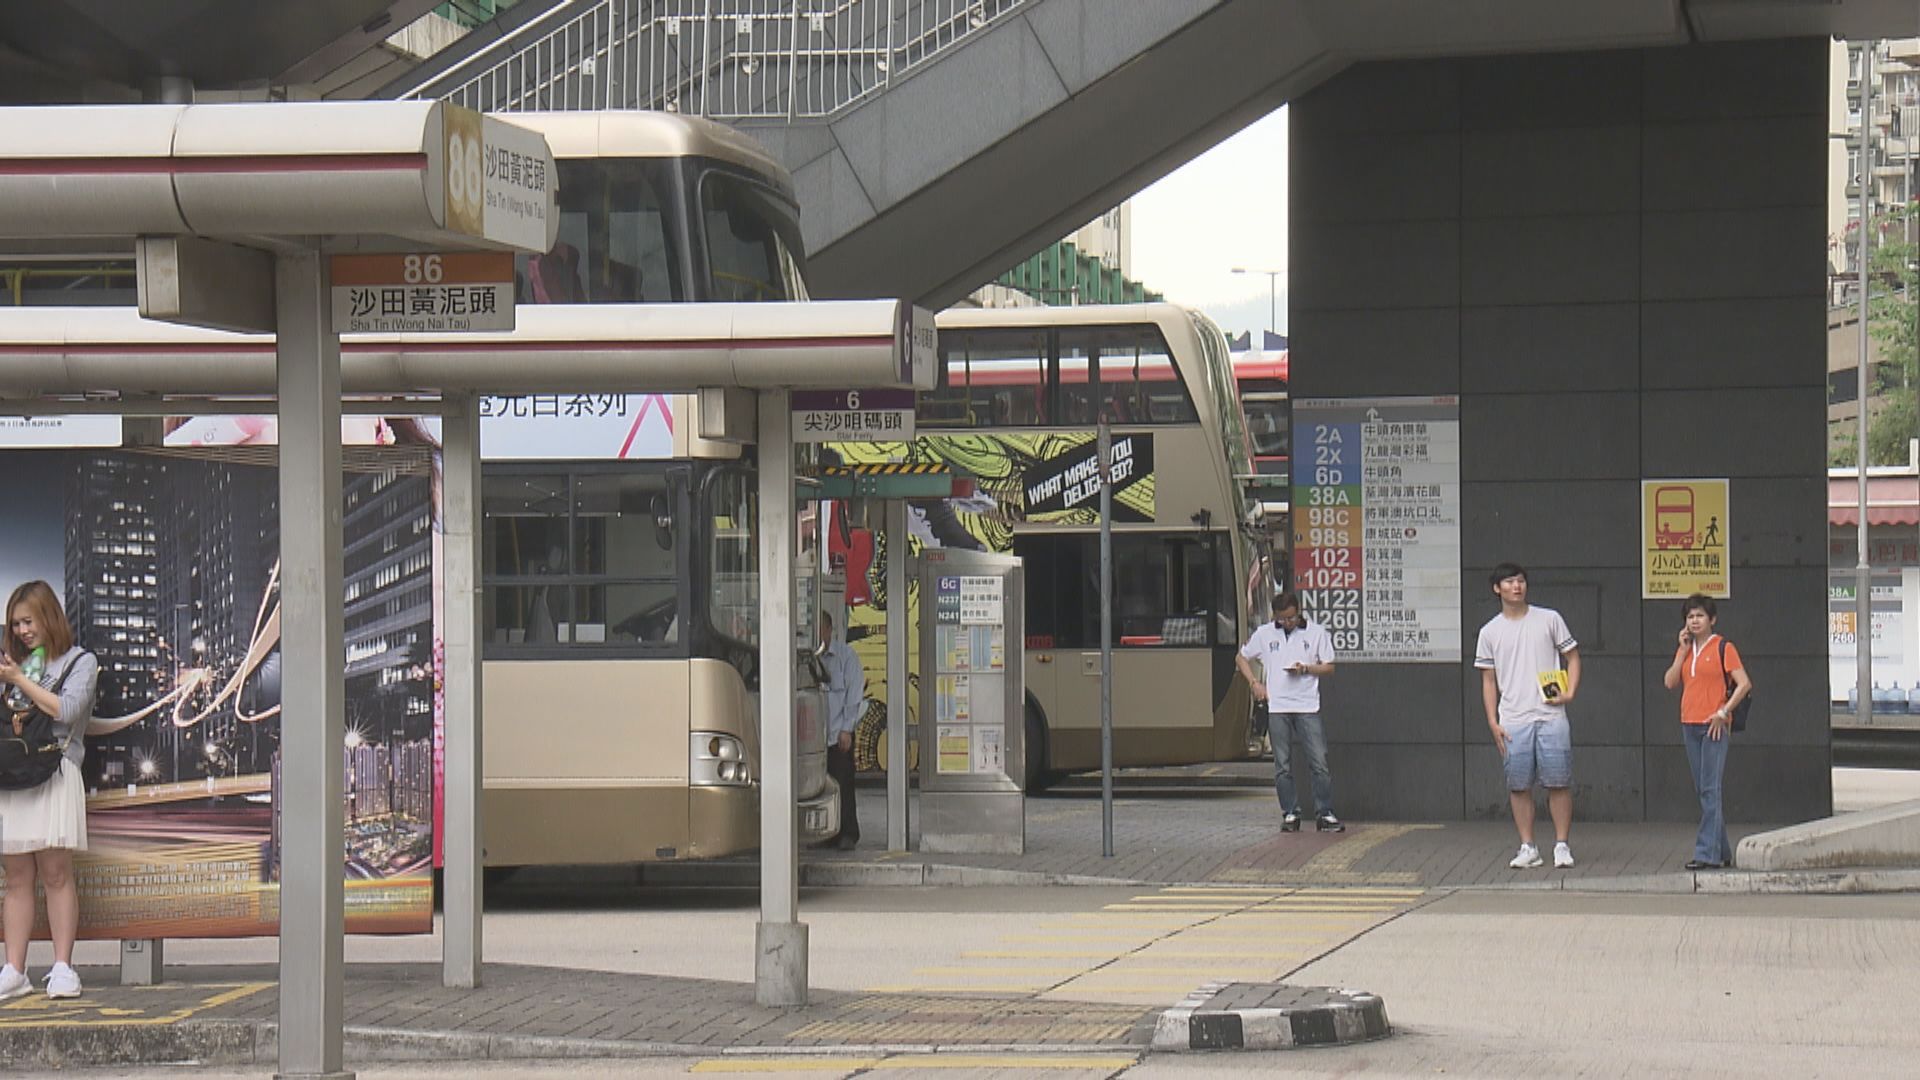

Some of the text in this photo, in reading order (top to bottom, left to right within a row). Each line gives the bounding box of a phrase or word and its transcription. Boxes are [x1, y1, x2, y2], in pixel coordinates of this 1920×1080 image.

[449, 129, 482, 219] 86
[486, 144, 545, 192] 沙田黃泥頭
[486, 189, 497, 208] Sha
[498, 192, 506, 209] Tin
[404, 254, 443, 284] 86
[350, 286, 497, 317] 沙田黃泥頭
[351, 318, 471, 332] Sha Tin (Wong Nai Tau)
[903, 321, 911, 364] 6
[846, 391, 860, 409] 6
[804, 412, 902, 431] 尖沙咀碼頭
[854, 431, 874, 441] Ferry
[1315, 425, 1342, 444] 2A
[1315, 446, 1342, 465] 2X
[1028, 474, 1062, 506] WHAT
[1064, 455, 1100, 488] MAKE
[1315, 467, 1342, 485] 6D
[1365, 466, 1401, 478] 牛頭角
[1309, 486, 1350, 505] 38A
[1309, 507, 1349, 526] 98C
[1309, 528, 1349, 547] 98S
[1311, 549, 1349, 567] 102
[1652, 553, 1720, 569] 小心車輛
[941, 578, 957, 589] 6C
[1304, 570, 1356, 588] 102P
[1302, 590, 1359, 609] N122
[938, 611, 959, 620] N241
[1302, 610, 1359, 629] N260
